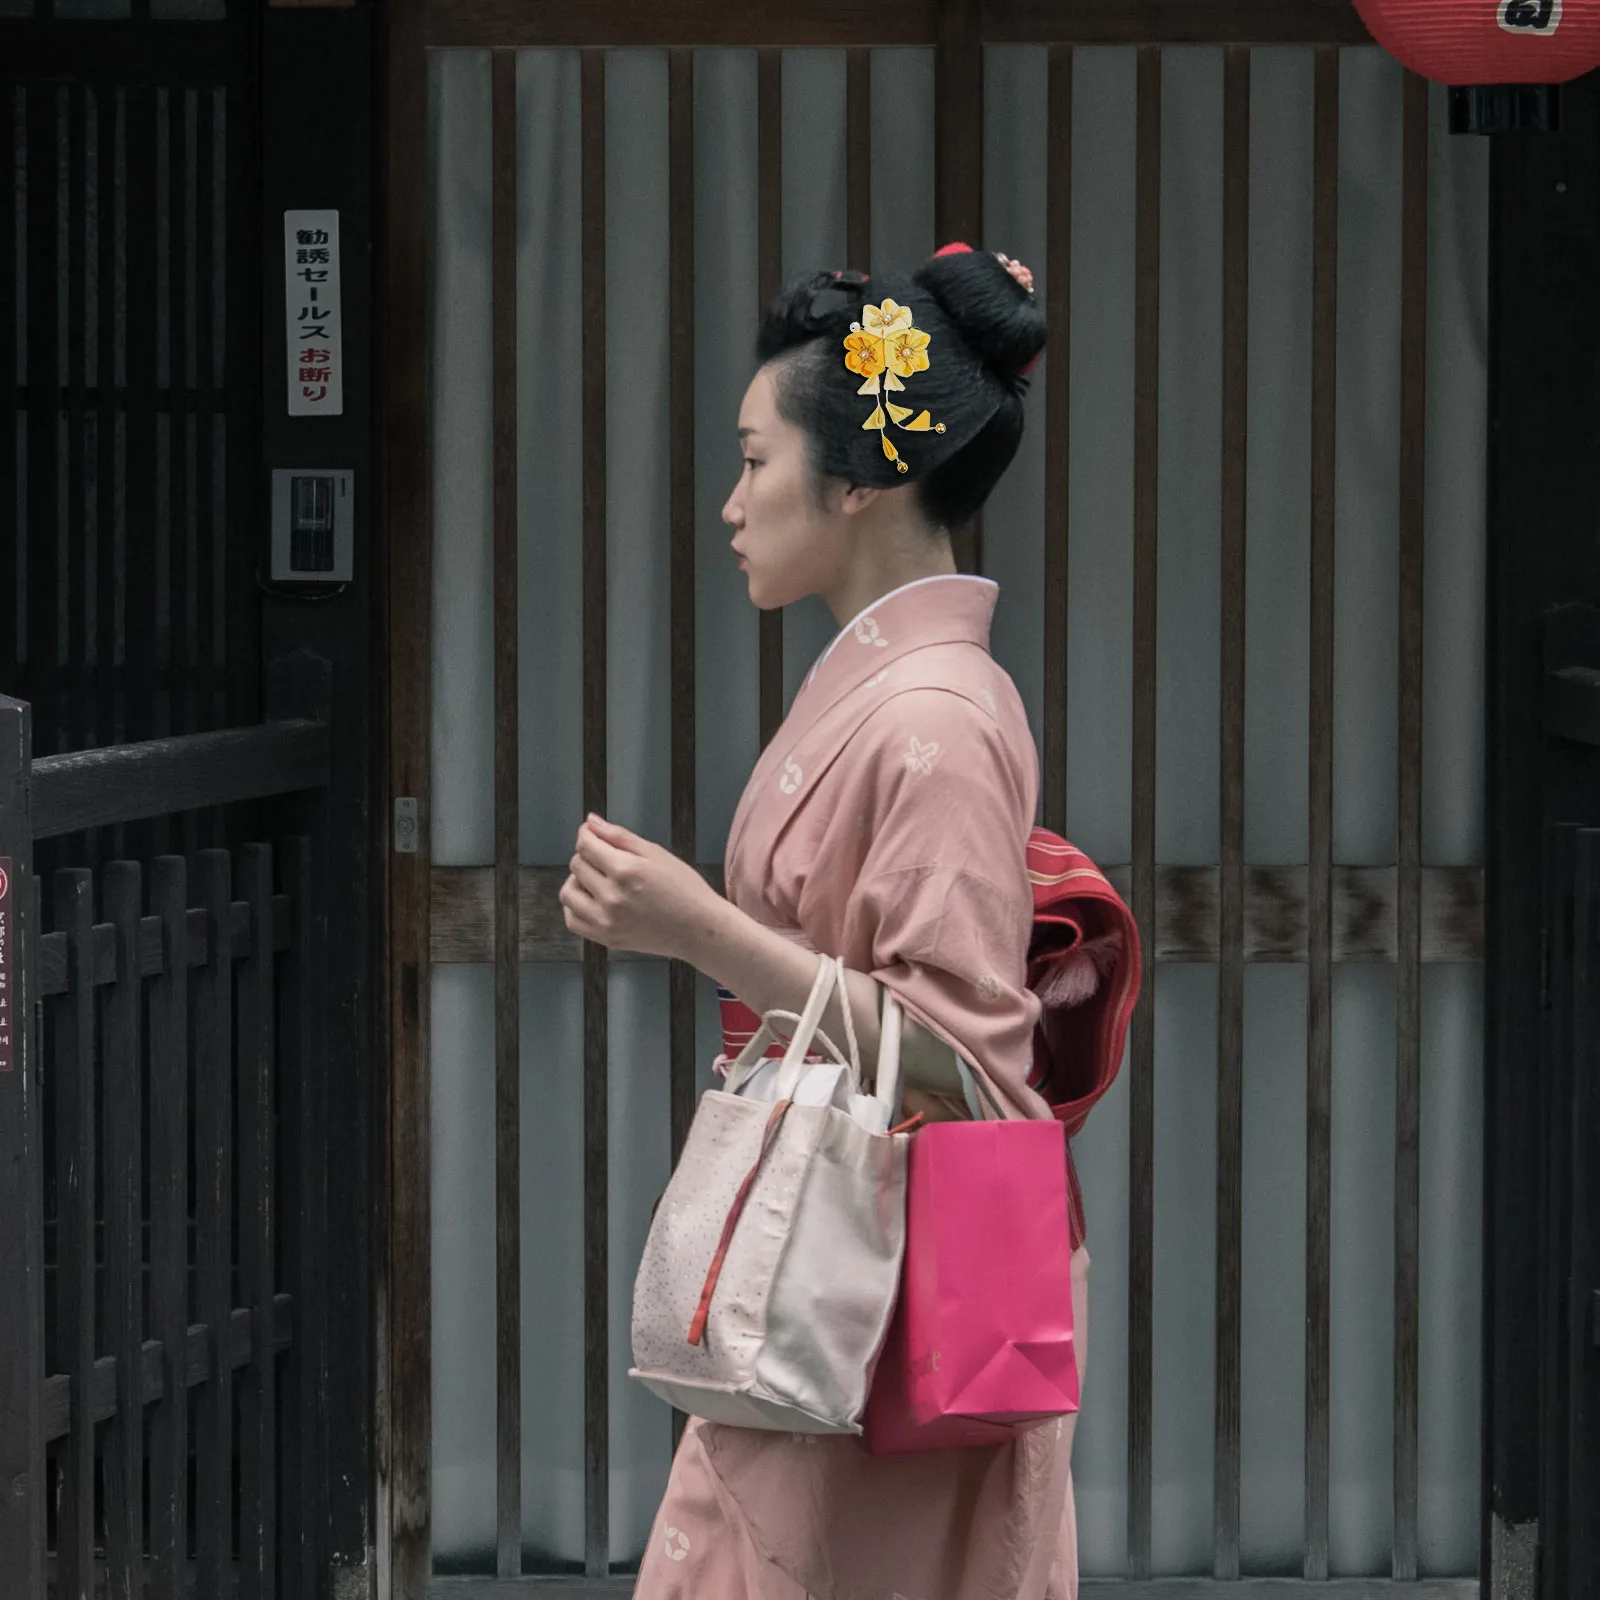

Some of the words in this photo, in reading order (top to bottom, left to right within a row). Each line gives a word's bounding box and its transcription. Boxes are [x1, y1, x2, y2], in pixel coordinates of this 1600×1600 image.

[296, 228, 333, 402] 勧誘セールスお断り
